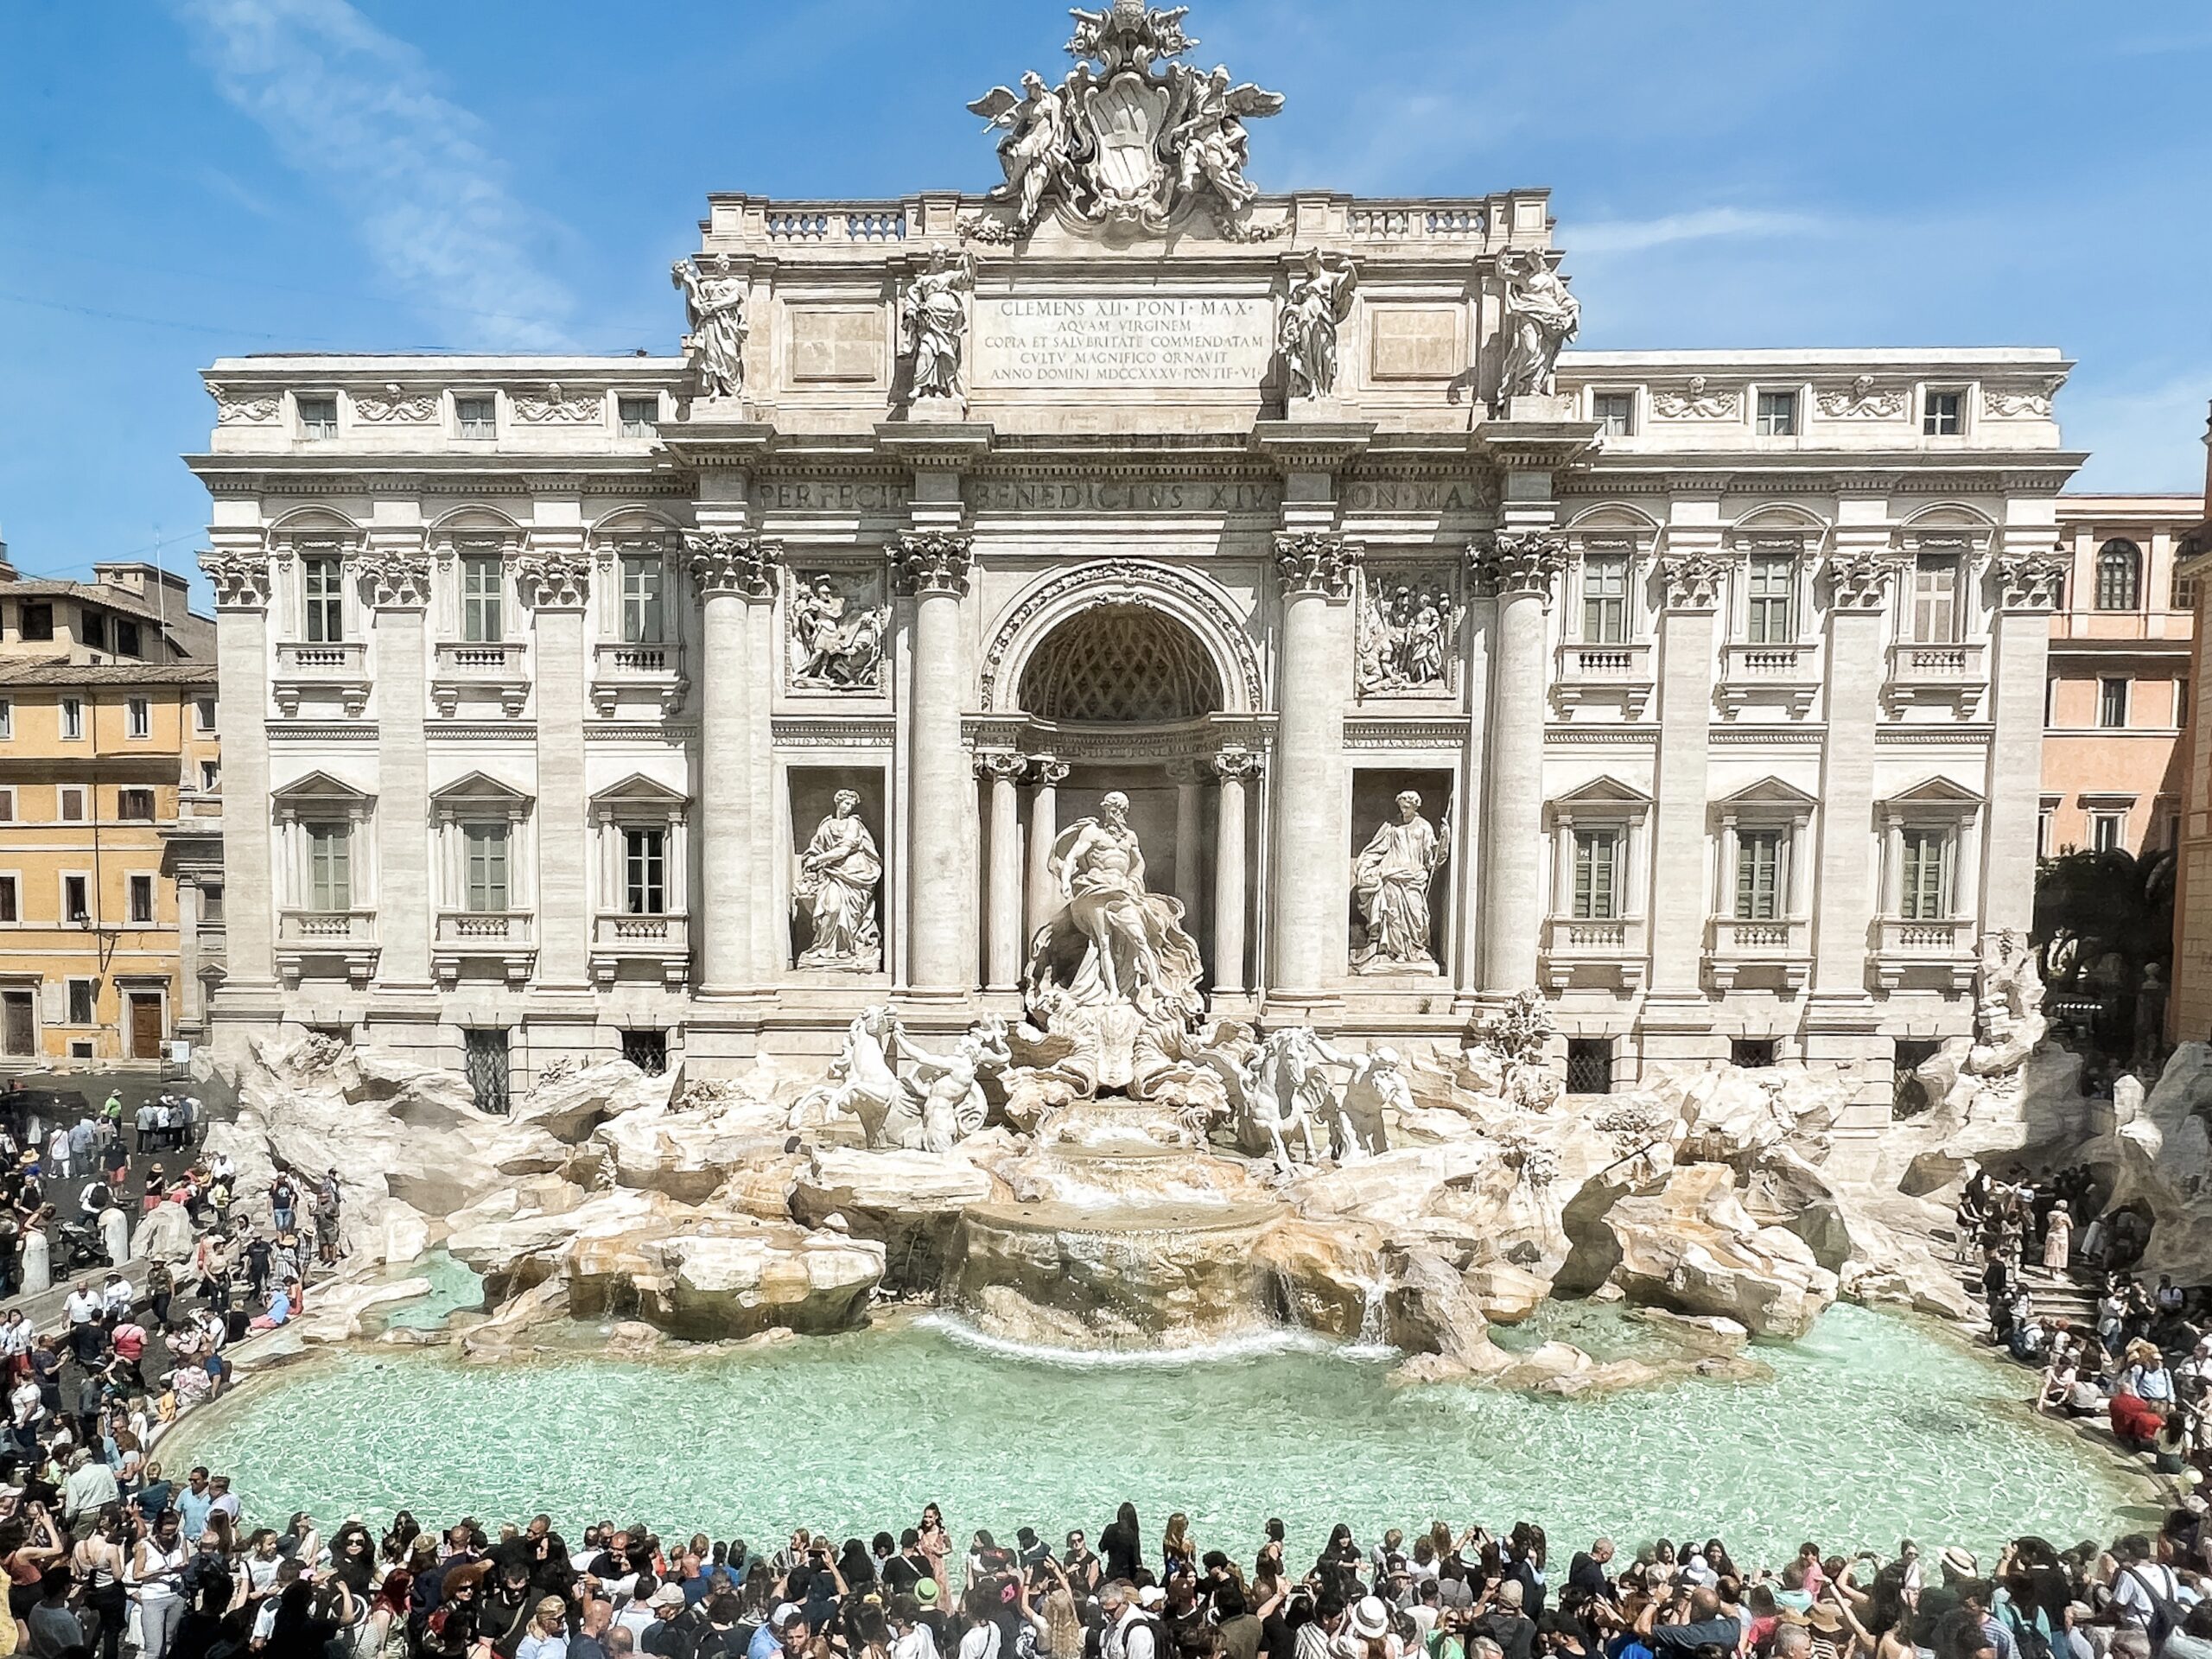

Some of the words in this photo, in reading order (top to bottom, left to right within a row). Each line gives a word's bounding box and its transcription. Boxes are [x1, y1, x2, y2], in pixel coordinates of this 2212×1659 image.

[1001, 302, 1085, 316] CLEMENS
[1058, 320, 1110, 335] AQVAM
[1119, 320, 1192, 332] VIRGINEM
[984, 336, 1027, 348] COPIA
[1033, 336, 1048, 348] ET
[1053, 335, 1143, 347] SALVBRITATE
[1150, 335, 1263, 347] COMMENDATAM
[1020, 352, 1067, 365] CVLTV
[1074, 352, 1156, 365] MAGNIFICO
[1162, 352, 1228, 365] ORNAVIT
[990, 368, 1033, 380] ANNO
[1037, 368, 1089, 380] DOMINI
[760, 484, 909, 508] PERFECIT
[1414, 483, 1492, 509] MAX
